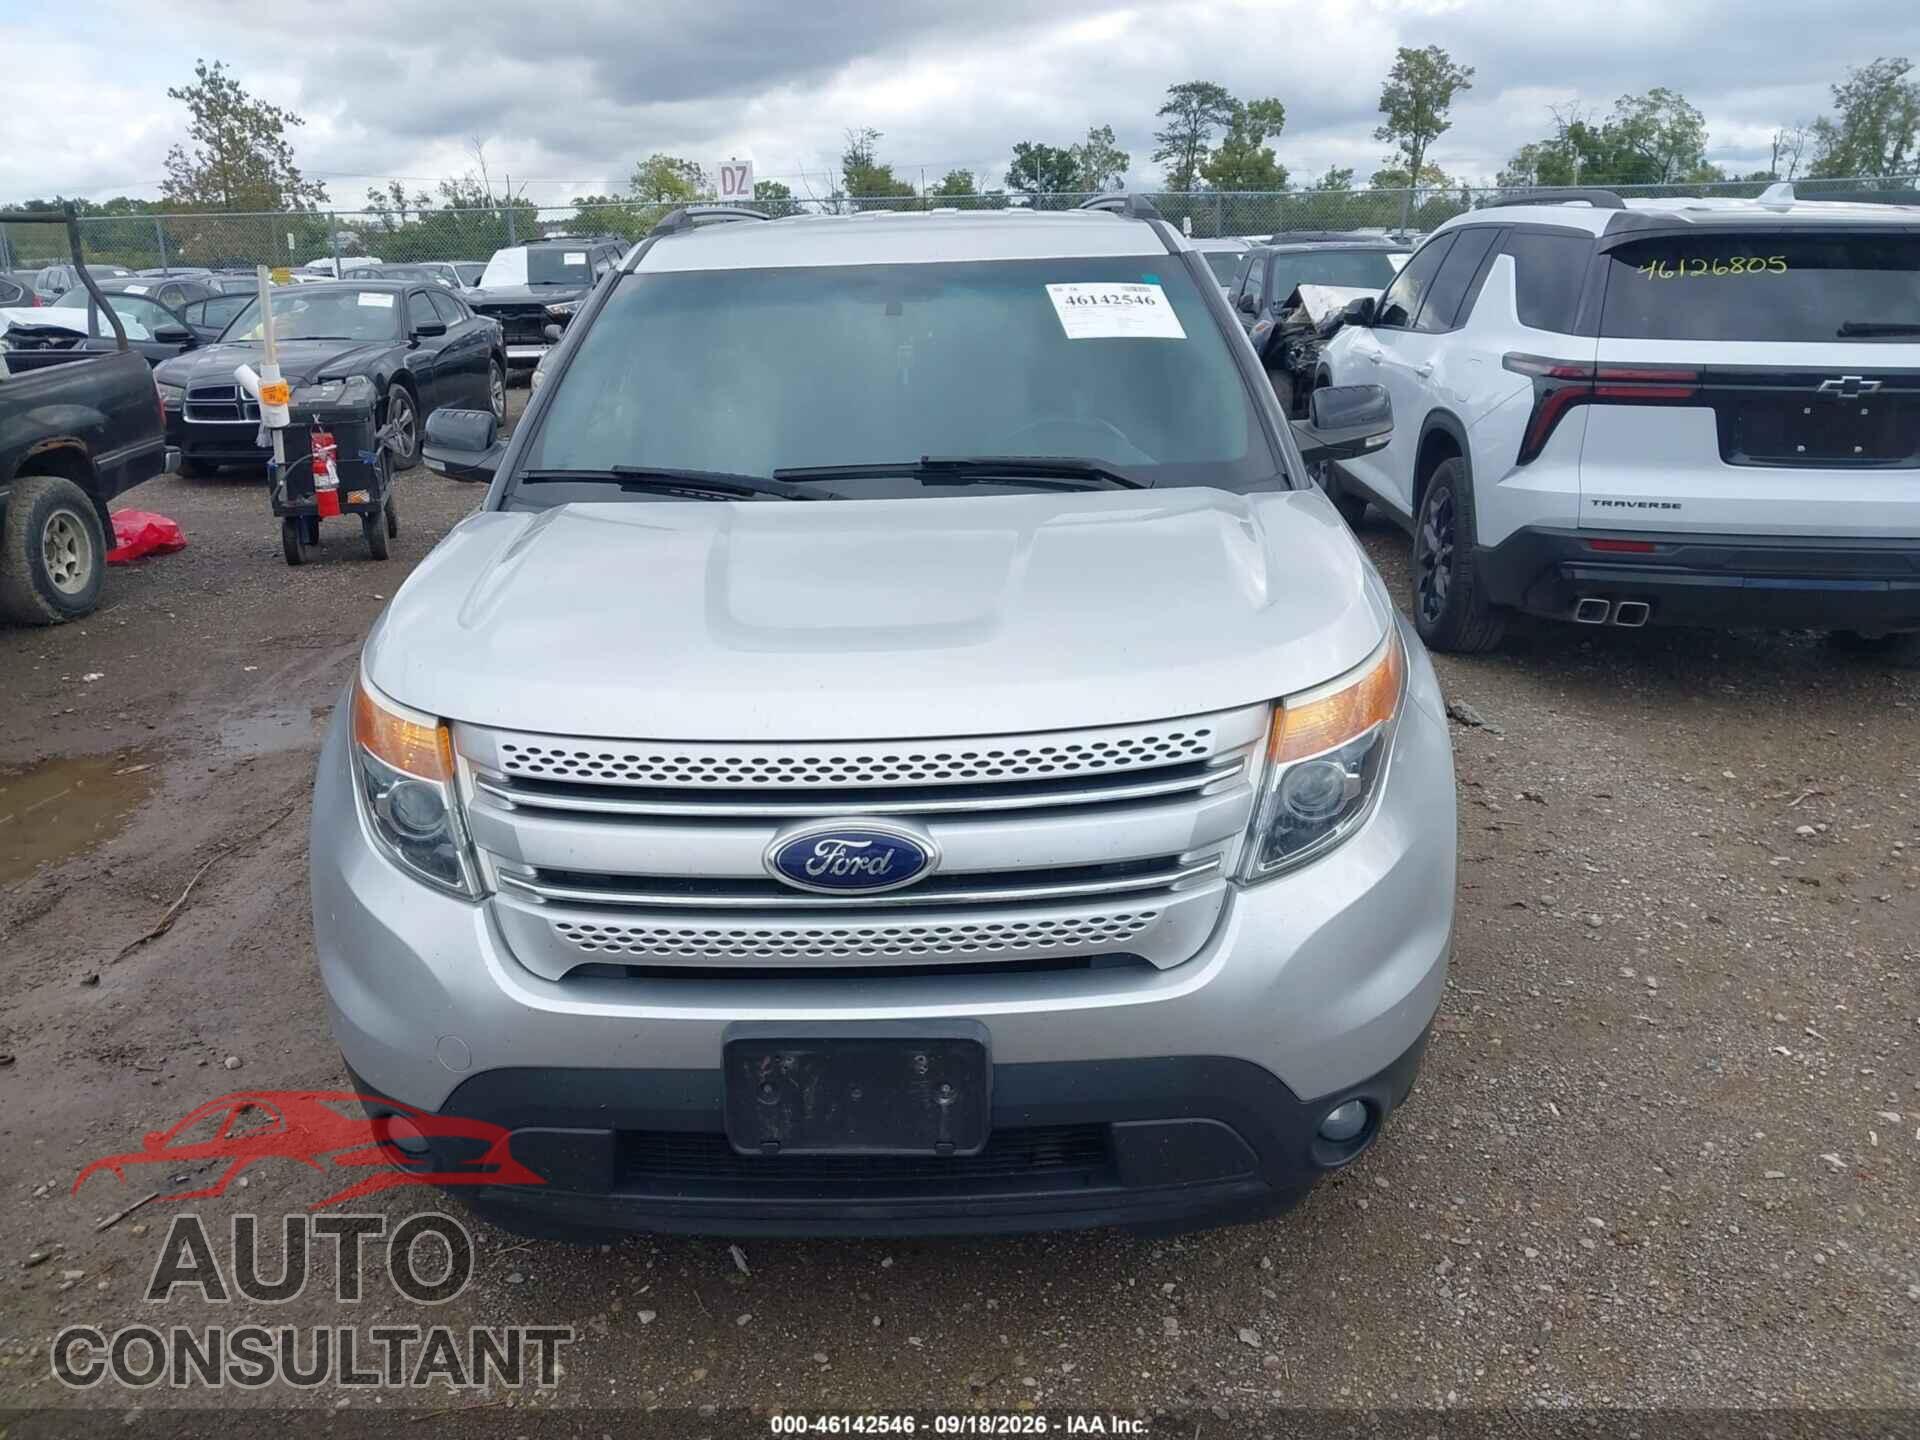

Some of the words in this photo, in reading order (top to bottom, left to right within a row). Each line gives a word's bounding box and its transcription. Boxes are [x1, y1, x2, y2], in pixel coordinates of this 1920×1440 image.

[721, 166, 749, 195] DZ
[1637, 255, 1788, 281] 46126805
[1065, 294, 1156, 306] 46142546
[1591, 499, 1682, 510] TRAVERSE
[805, 839, 896, 877] Ford
